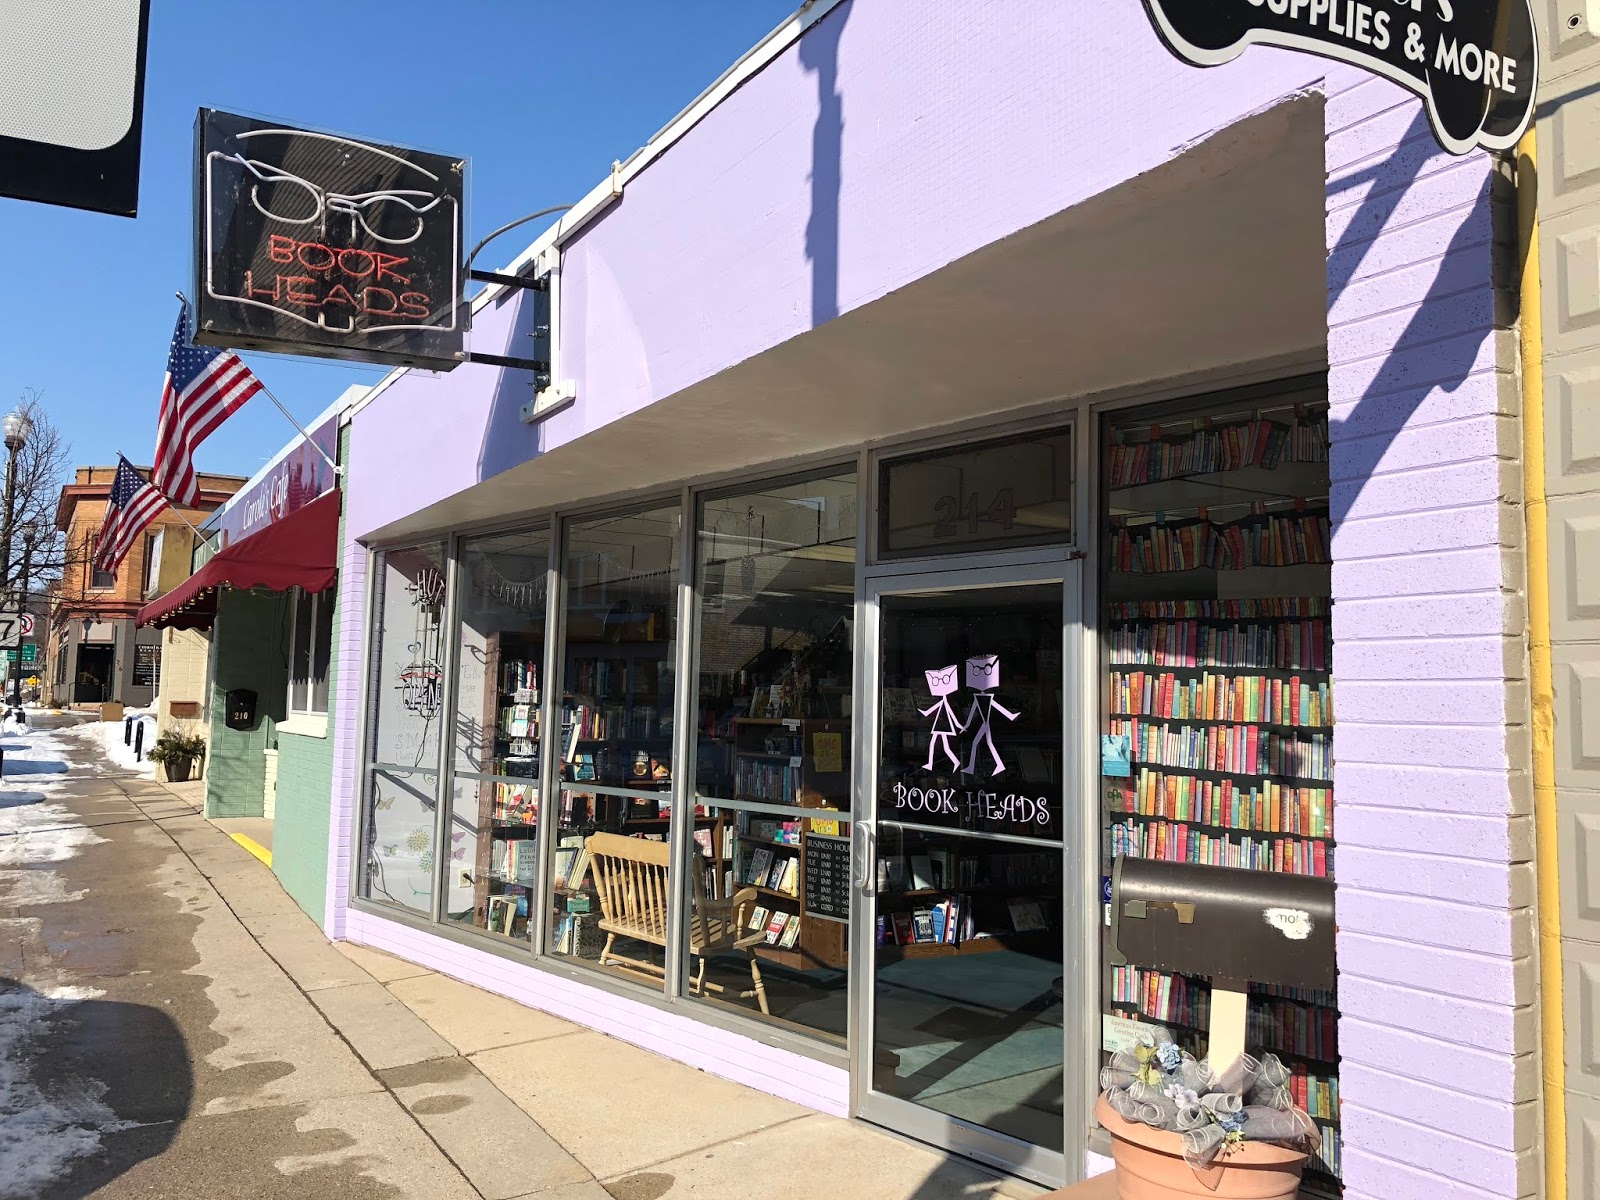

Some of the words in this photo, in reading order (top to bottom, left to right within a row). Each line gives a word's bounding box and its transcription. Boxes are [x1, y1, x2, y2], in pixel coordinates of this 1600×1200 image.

[1404, 22, 1426, 63] &
[1434, 32, 1517, 94] MORE
[269, 234, 410, 285] BOOK
[244, 270, 430, 319] HEADS
[932, 487, 1017, 538] 214
[234, 711, 249, 720] 210
[892, 781, 959, 814] BOOK
[964, 789, 1051, 826] HEADS
[807, 839, 832, 850] BUSINESS
